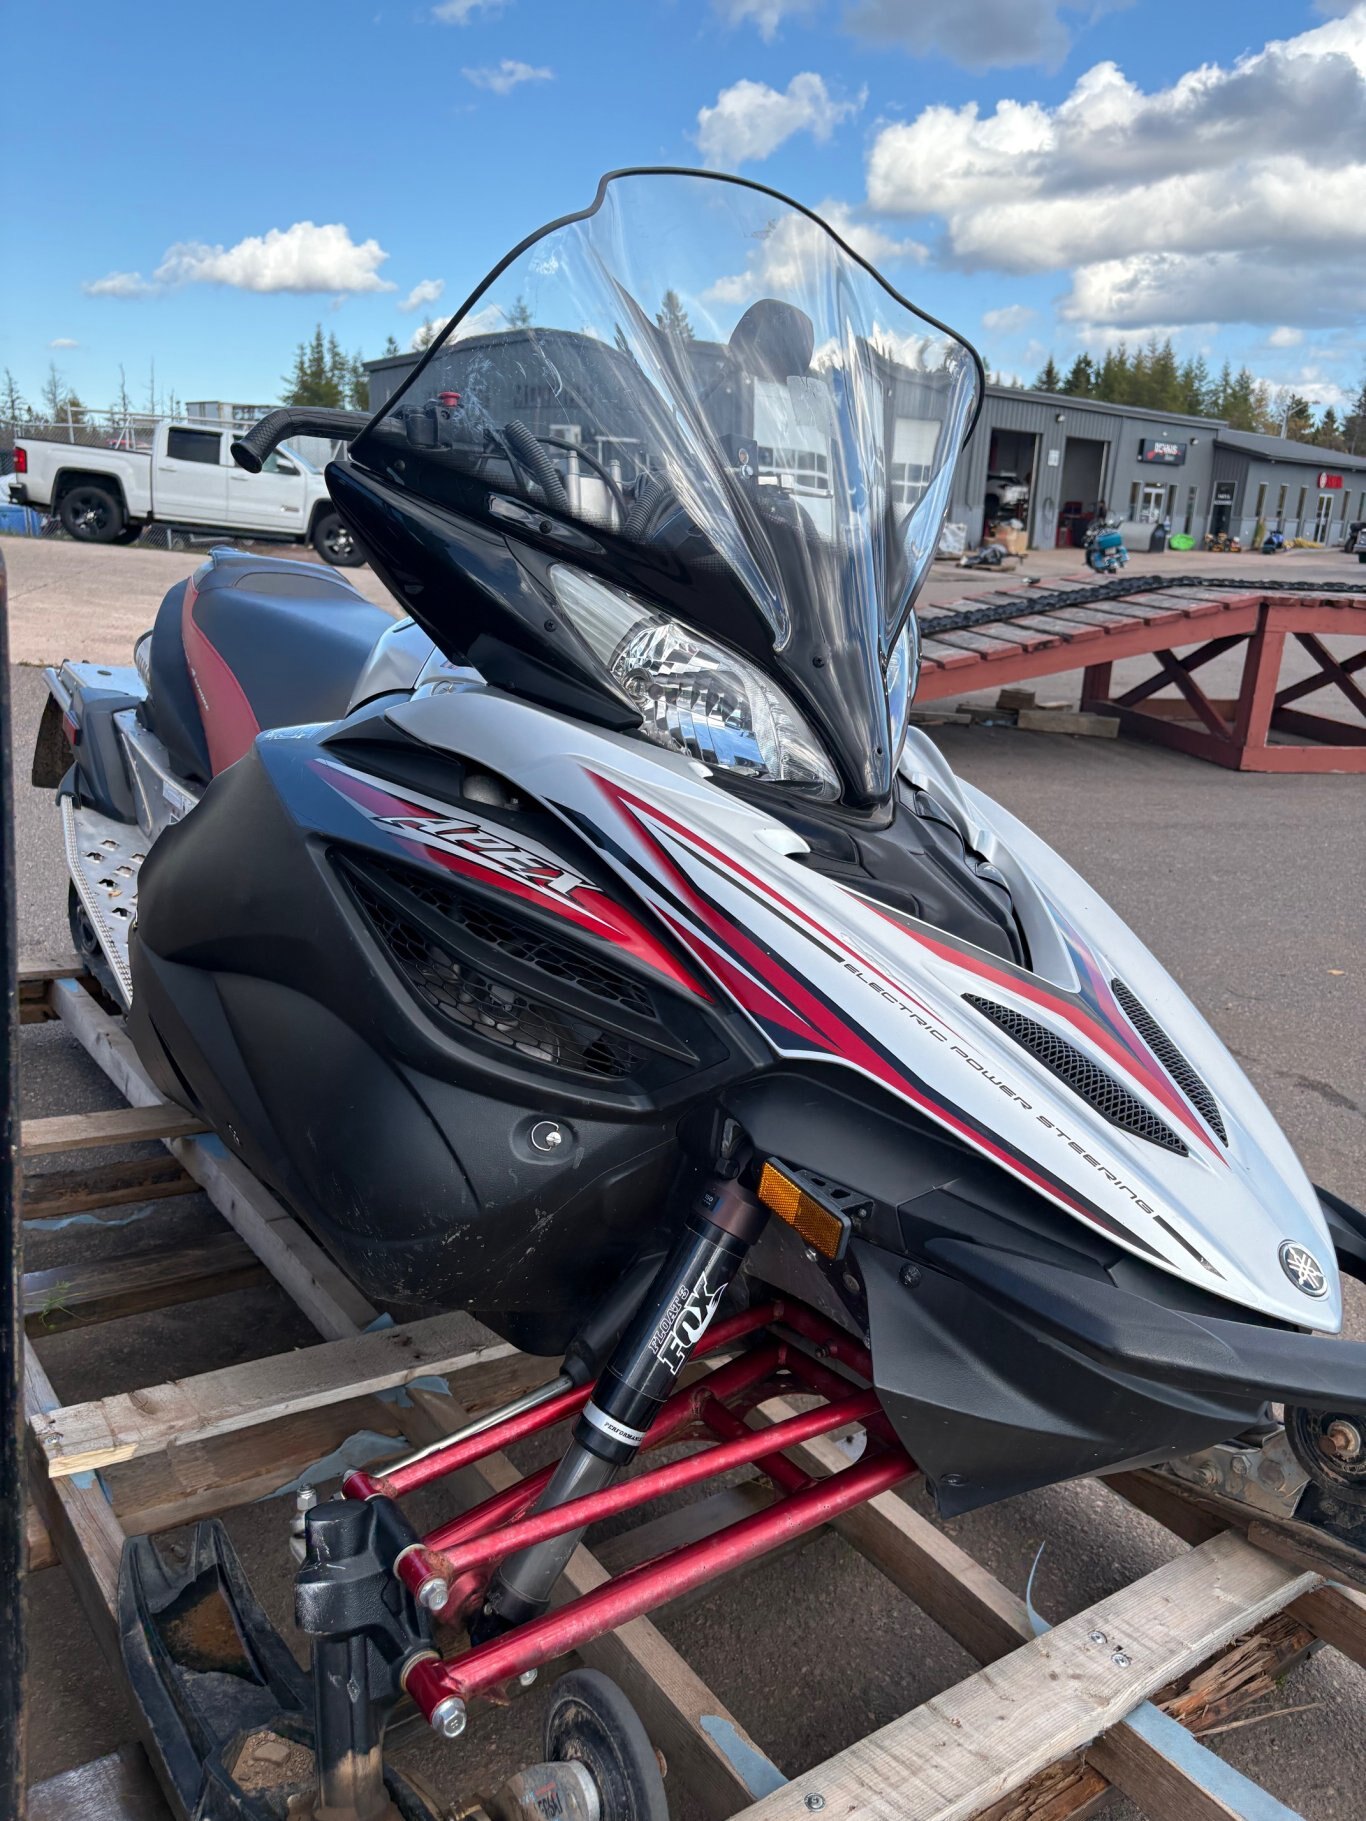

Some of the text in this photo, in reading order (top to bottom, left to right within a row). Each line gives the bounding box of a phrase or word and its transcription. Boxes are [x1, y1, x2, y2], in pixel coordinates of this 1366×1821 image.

[371, 816, 606, 908] APEX
[843, 963, 1156, 1216] ELECTRIC POWER STEERING
[648, 1284, 690, 1355] FLOAT 3
[657, 1271, 726, 1375] FOX
